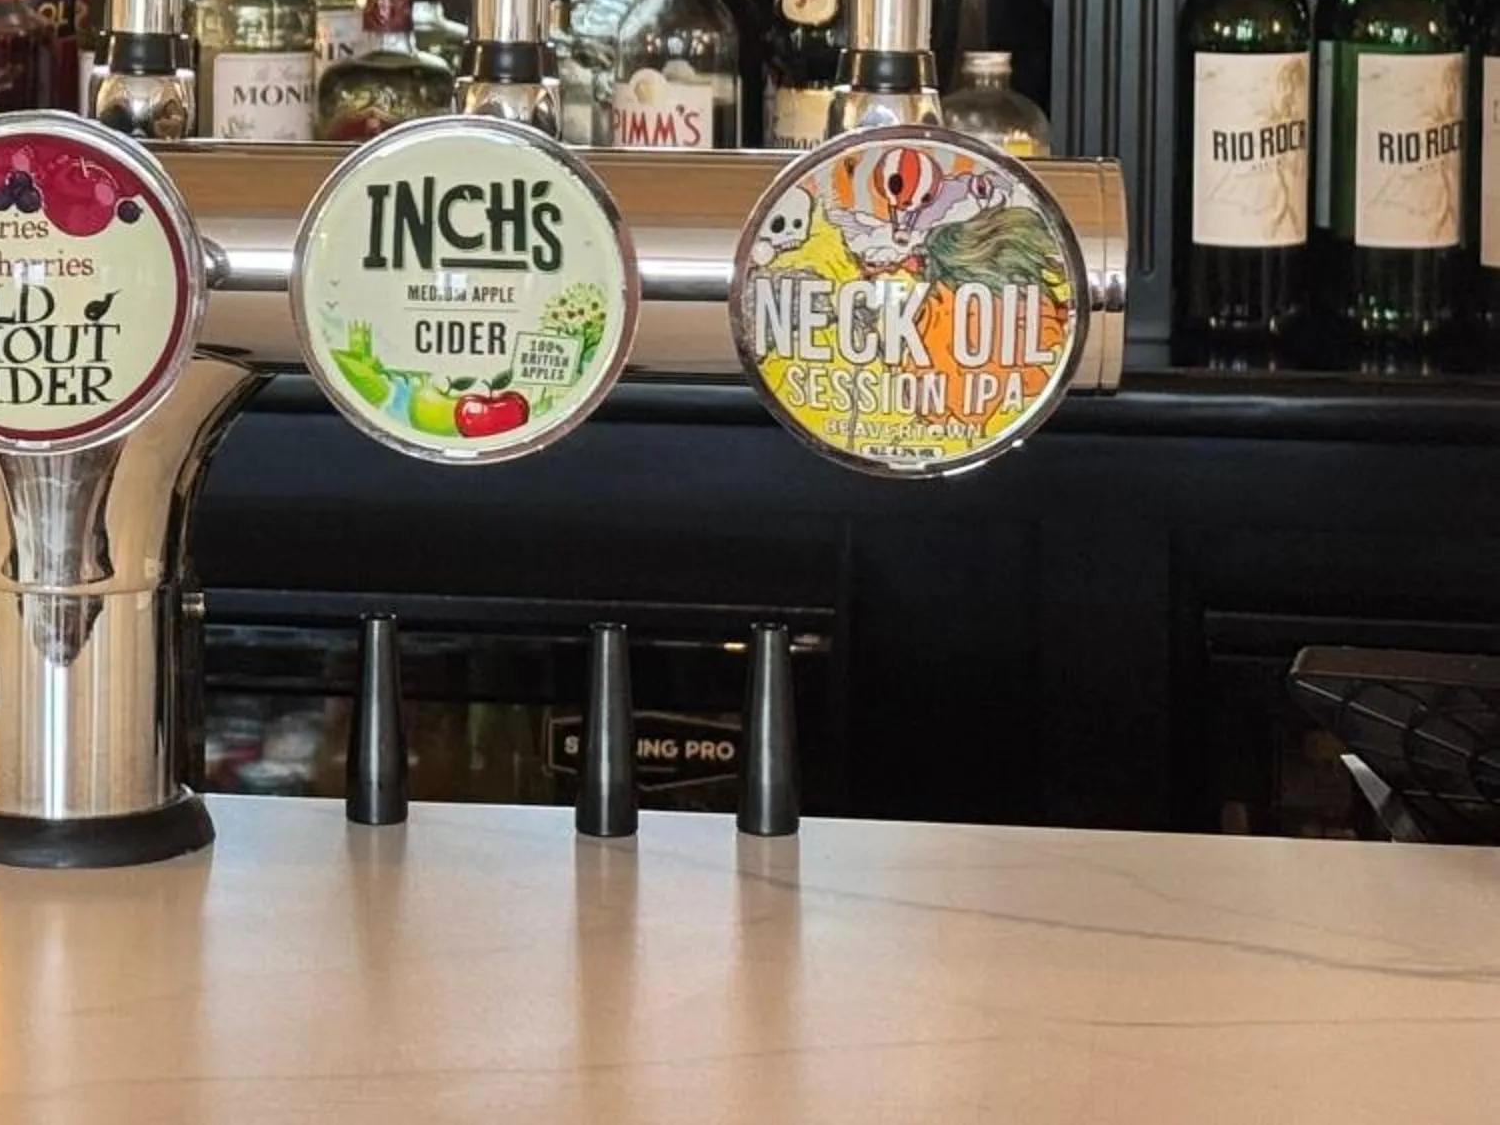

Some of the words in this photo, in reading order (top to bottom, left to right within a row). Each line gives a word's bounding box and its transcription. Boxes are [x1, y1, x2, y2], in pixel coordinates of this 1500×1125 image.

[1212, 129, 1255, 163] RIO
[1377, 130, 1422, 164] RIO
[471, 285, 516, 304] APPLE
[415, 320, 507, 355] CIDER
[754, 277, 933, 370] NECK
[953, 283, 1056, 369] OIL
[520, 352, 570, 368] BRITISH
[520, 366, 565, 381] APPLES
[786, 365, 947, 416] SESSION
[963, 371, 1027, 416] IPA
[685, 739, 736, 762] PRO
